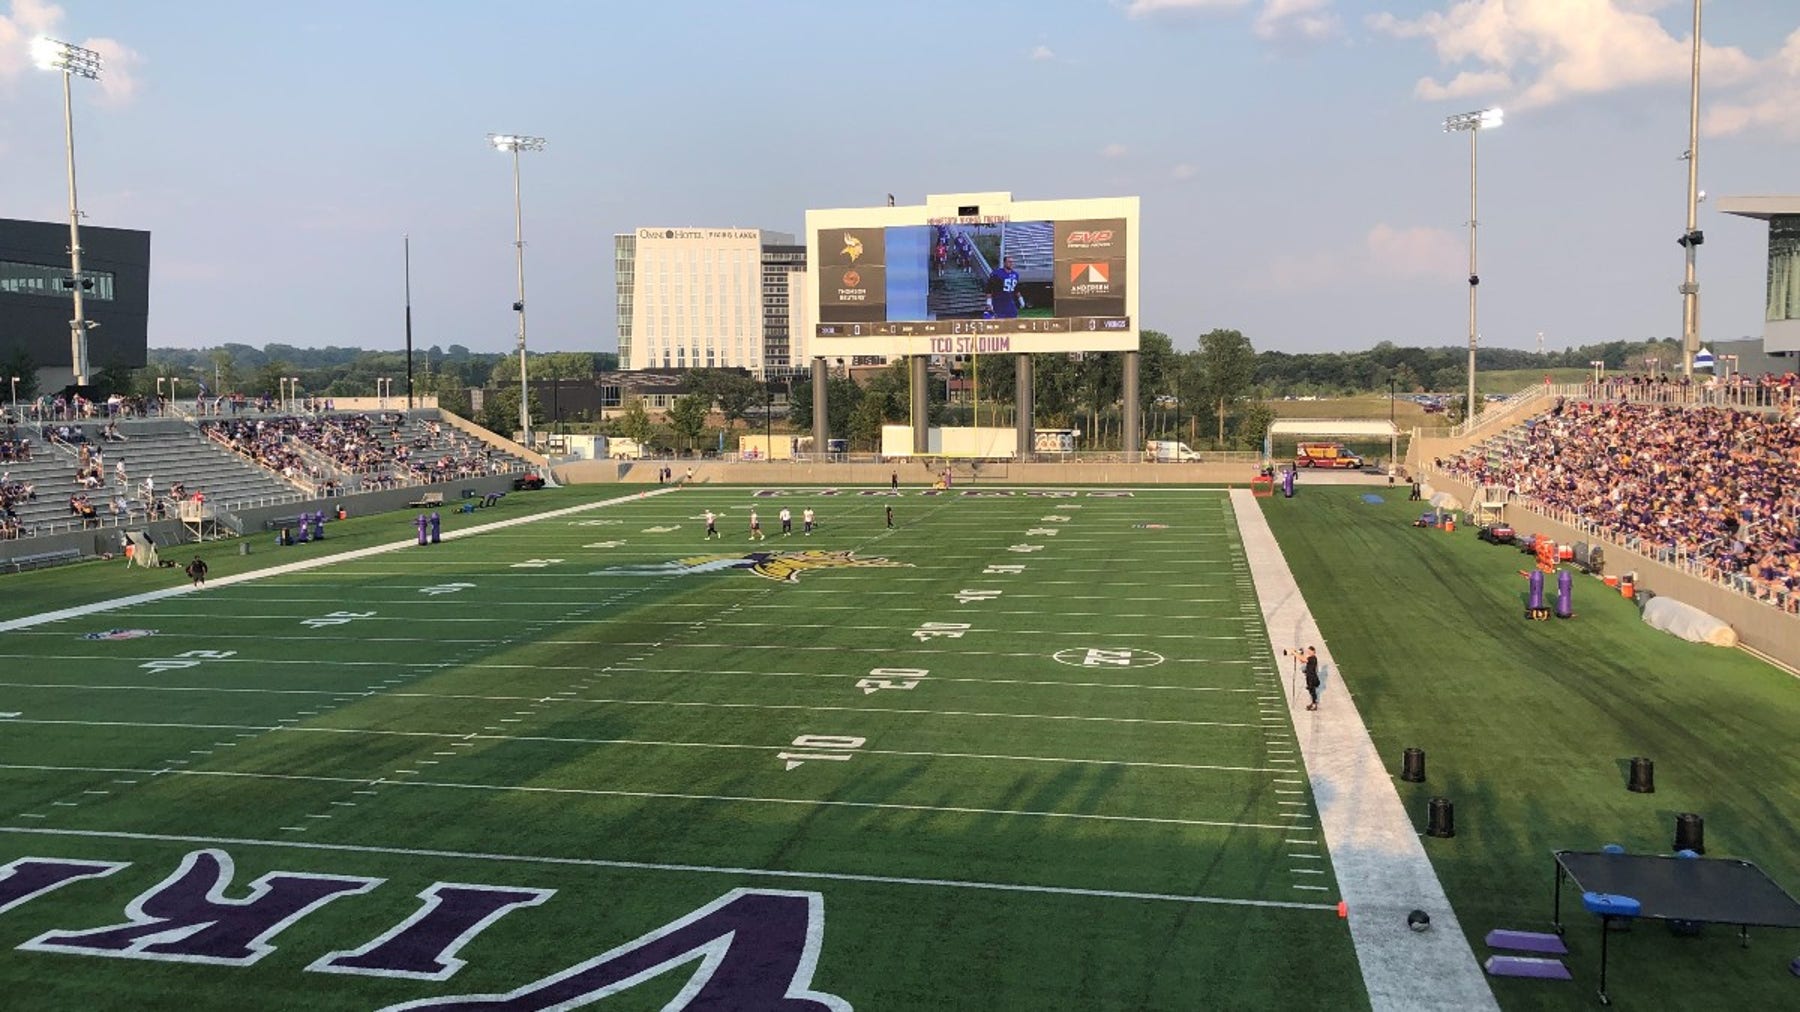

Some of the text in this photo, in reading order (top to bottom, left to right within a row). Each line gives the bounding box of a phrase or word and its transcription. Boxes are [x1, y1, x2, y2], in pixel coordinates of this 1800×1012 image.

[854, 324, 861, 335] 0
[930, 337, 1010, 352] TCO STADIUM
[911, 621, 972, 640] 30
[855, 668, 930, 692] 20
[776, 734, 867, 764] 10
